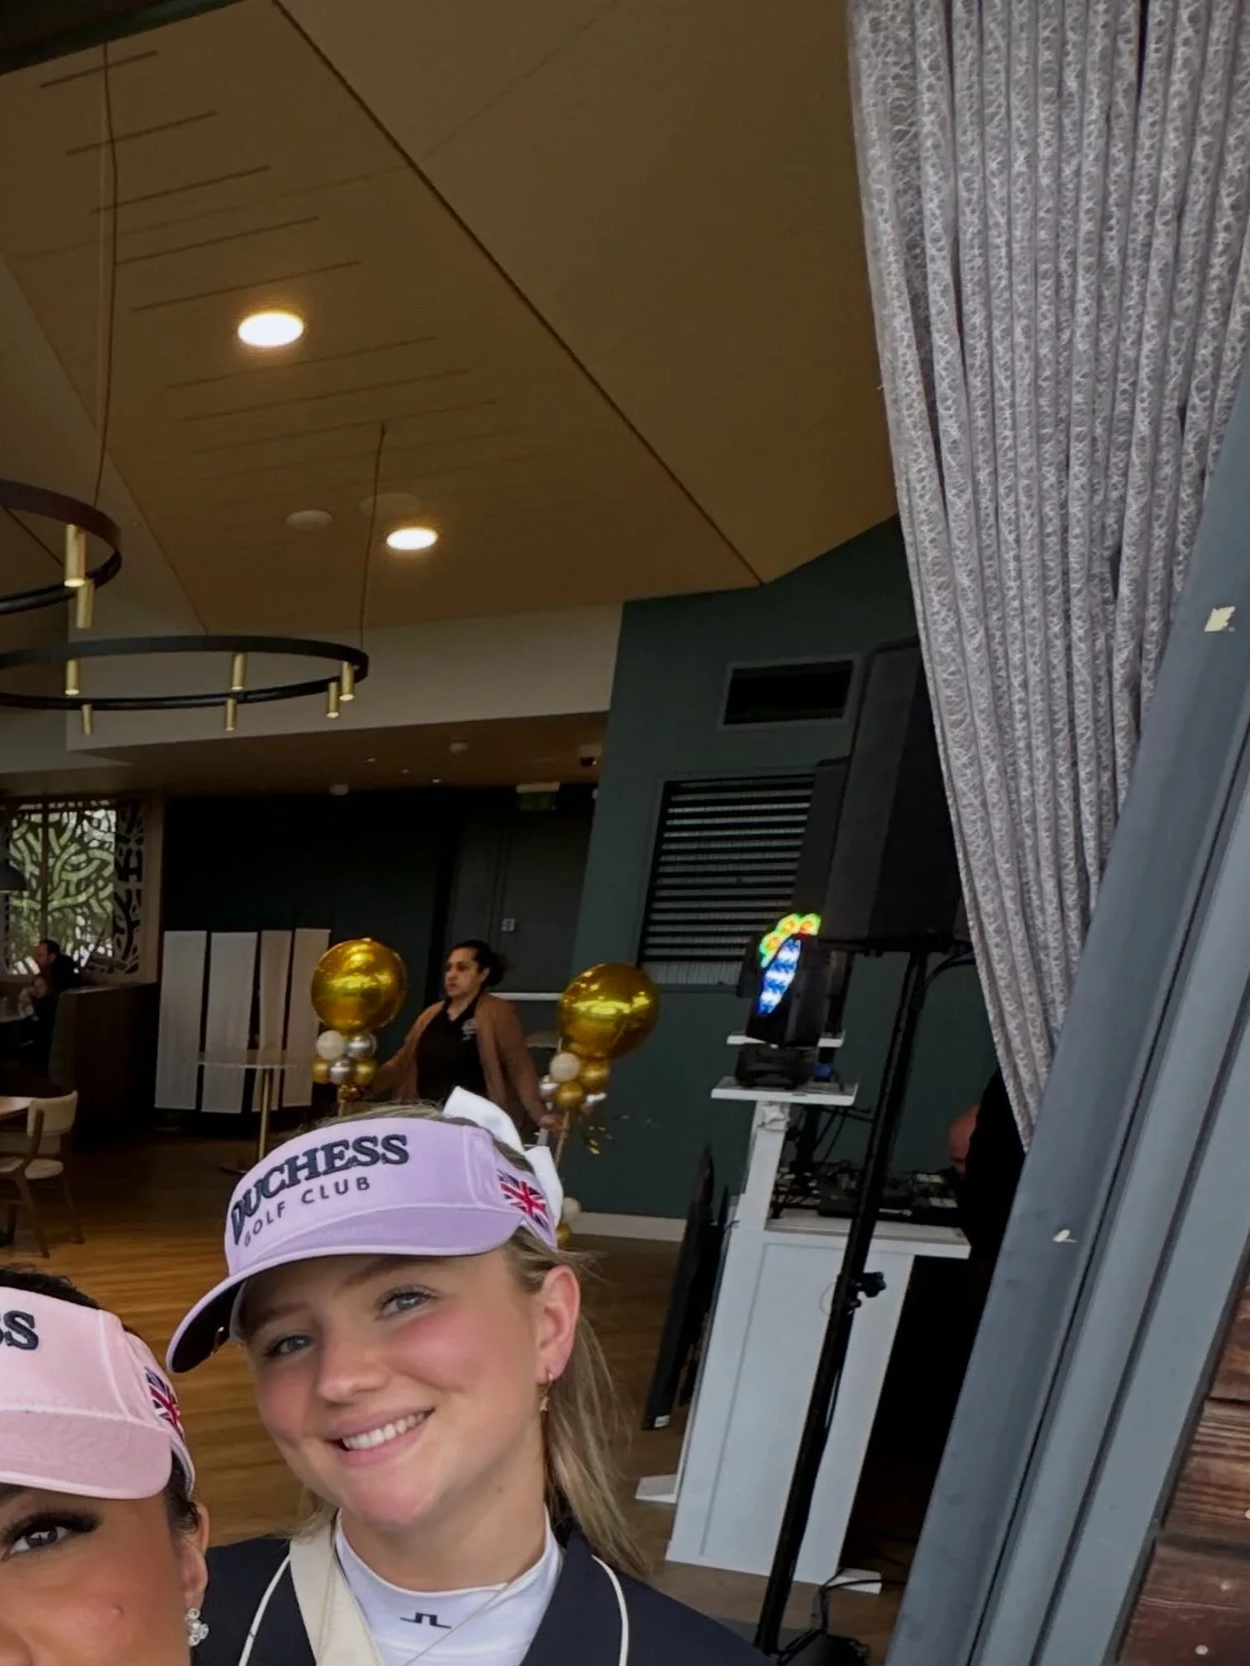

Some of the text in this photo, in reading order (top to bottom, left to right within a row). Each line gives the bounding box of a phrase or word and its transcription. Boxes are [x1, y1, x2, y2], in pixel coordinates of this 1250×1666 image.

[230, 1133, 410, 1246] DUCHESS
[244, 1176, 371, 1248] GOLF CLUB
